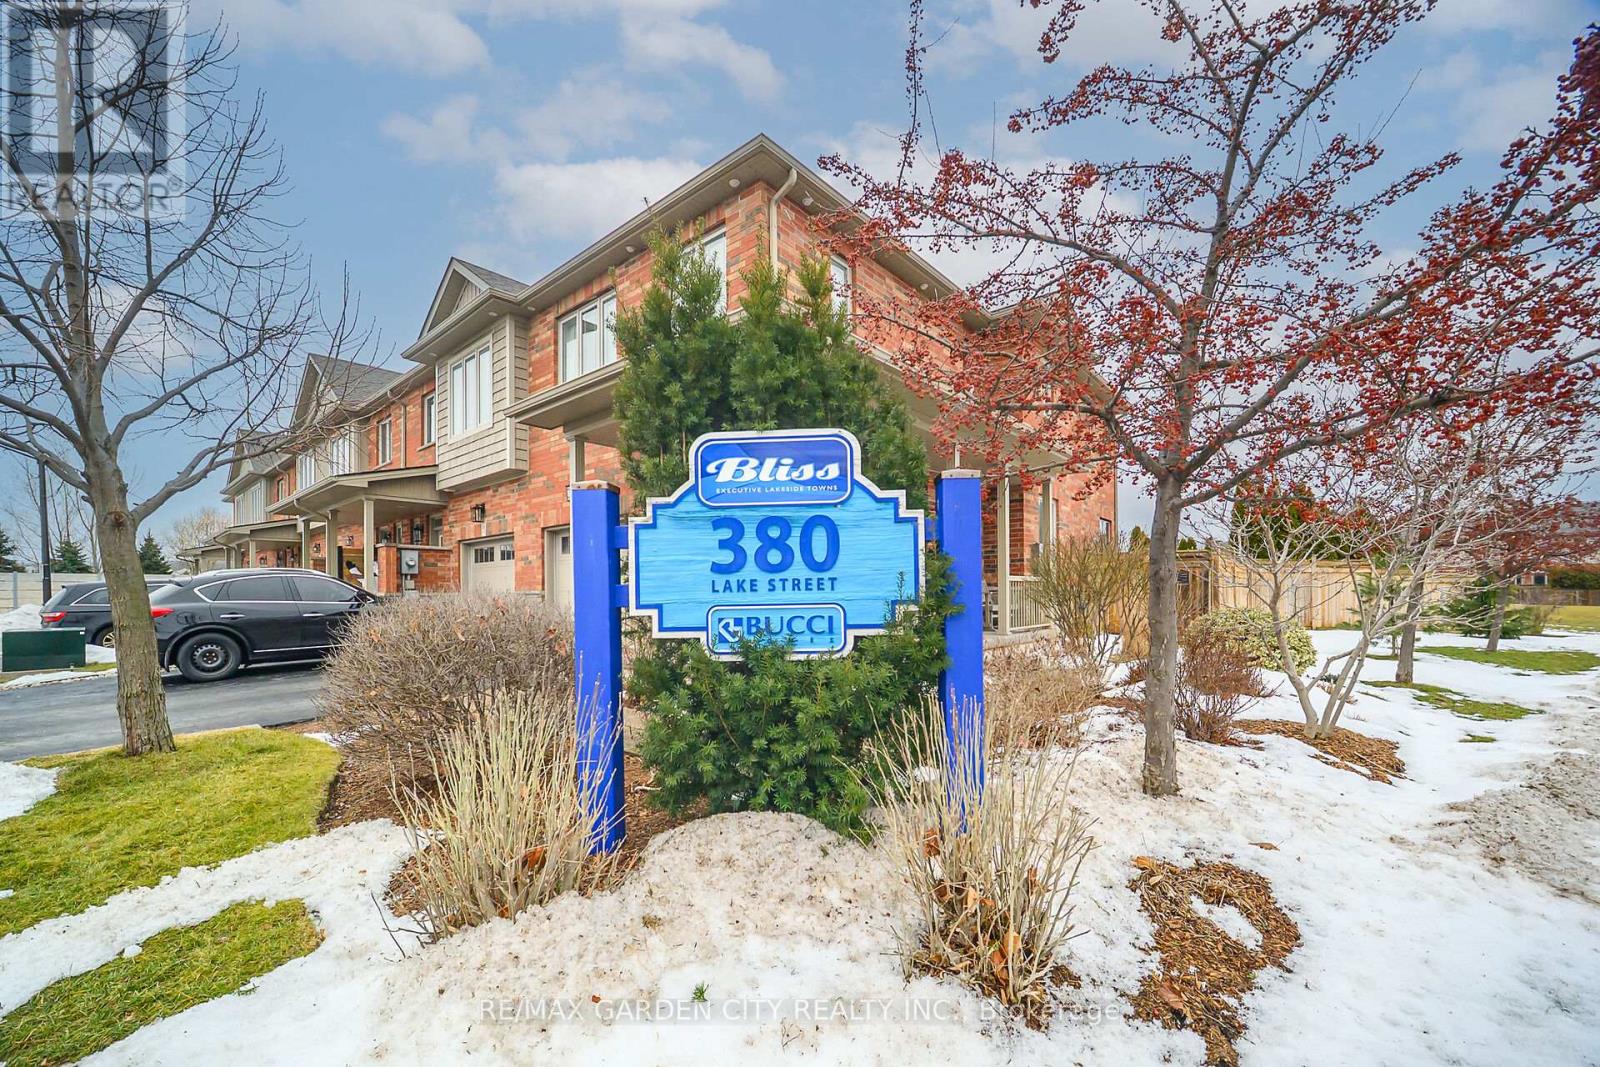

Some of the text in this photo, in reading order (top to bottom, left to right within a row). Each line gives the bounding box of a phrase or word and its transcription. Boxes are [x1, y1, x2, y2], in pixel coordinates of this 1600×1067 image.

[706, 457, 840, 482] Bliss
[716, 484, 838, 494] EXECUTIVE LAKESIDE TOWNS
[710, 514, 840, 574] 380
[711, 576, 837, 593] LAKE STREET
[746, 615, 834, 635] BUCCI
